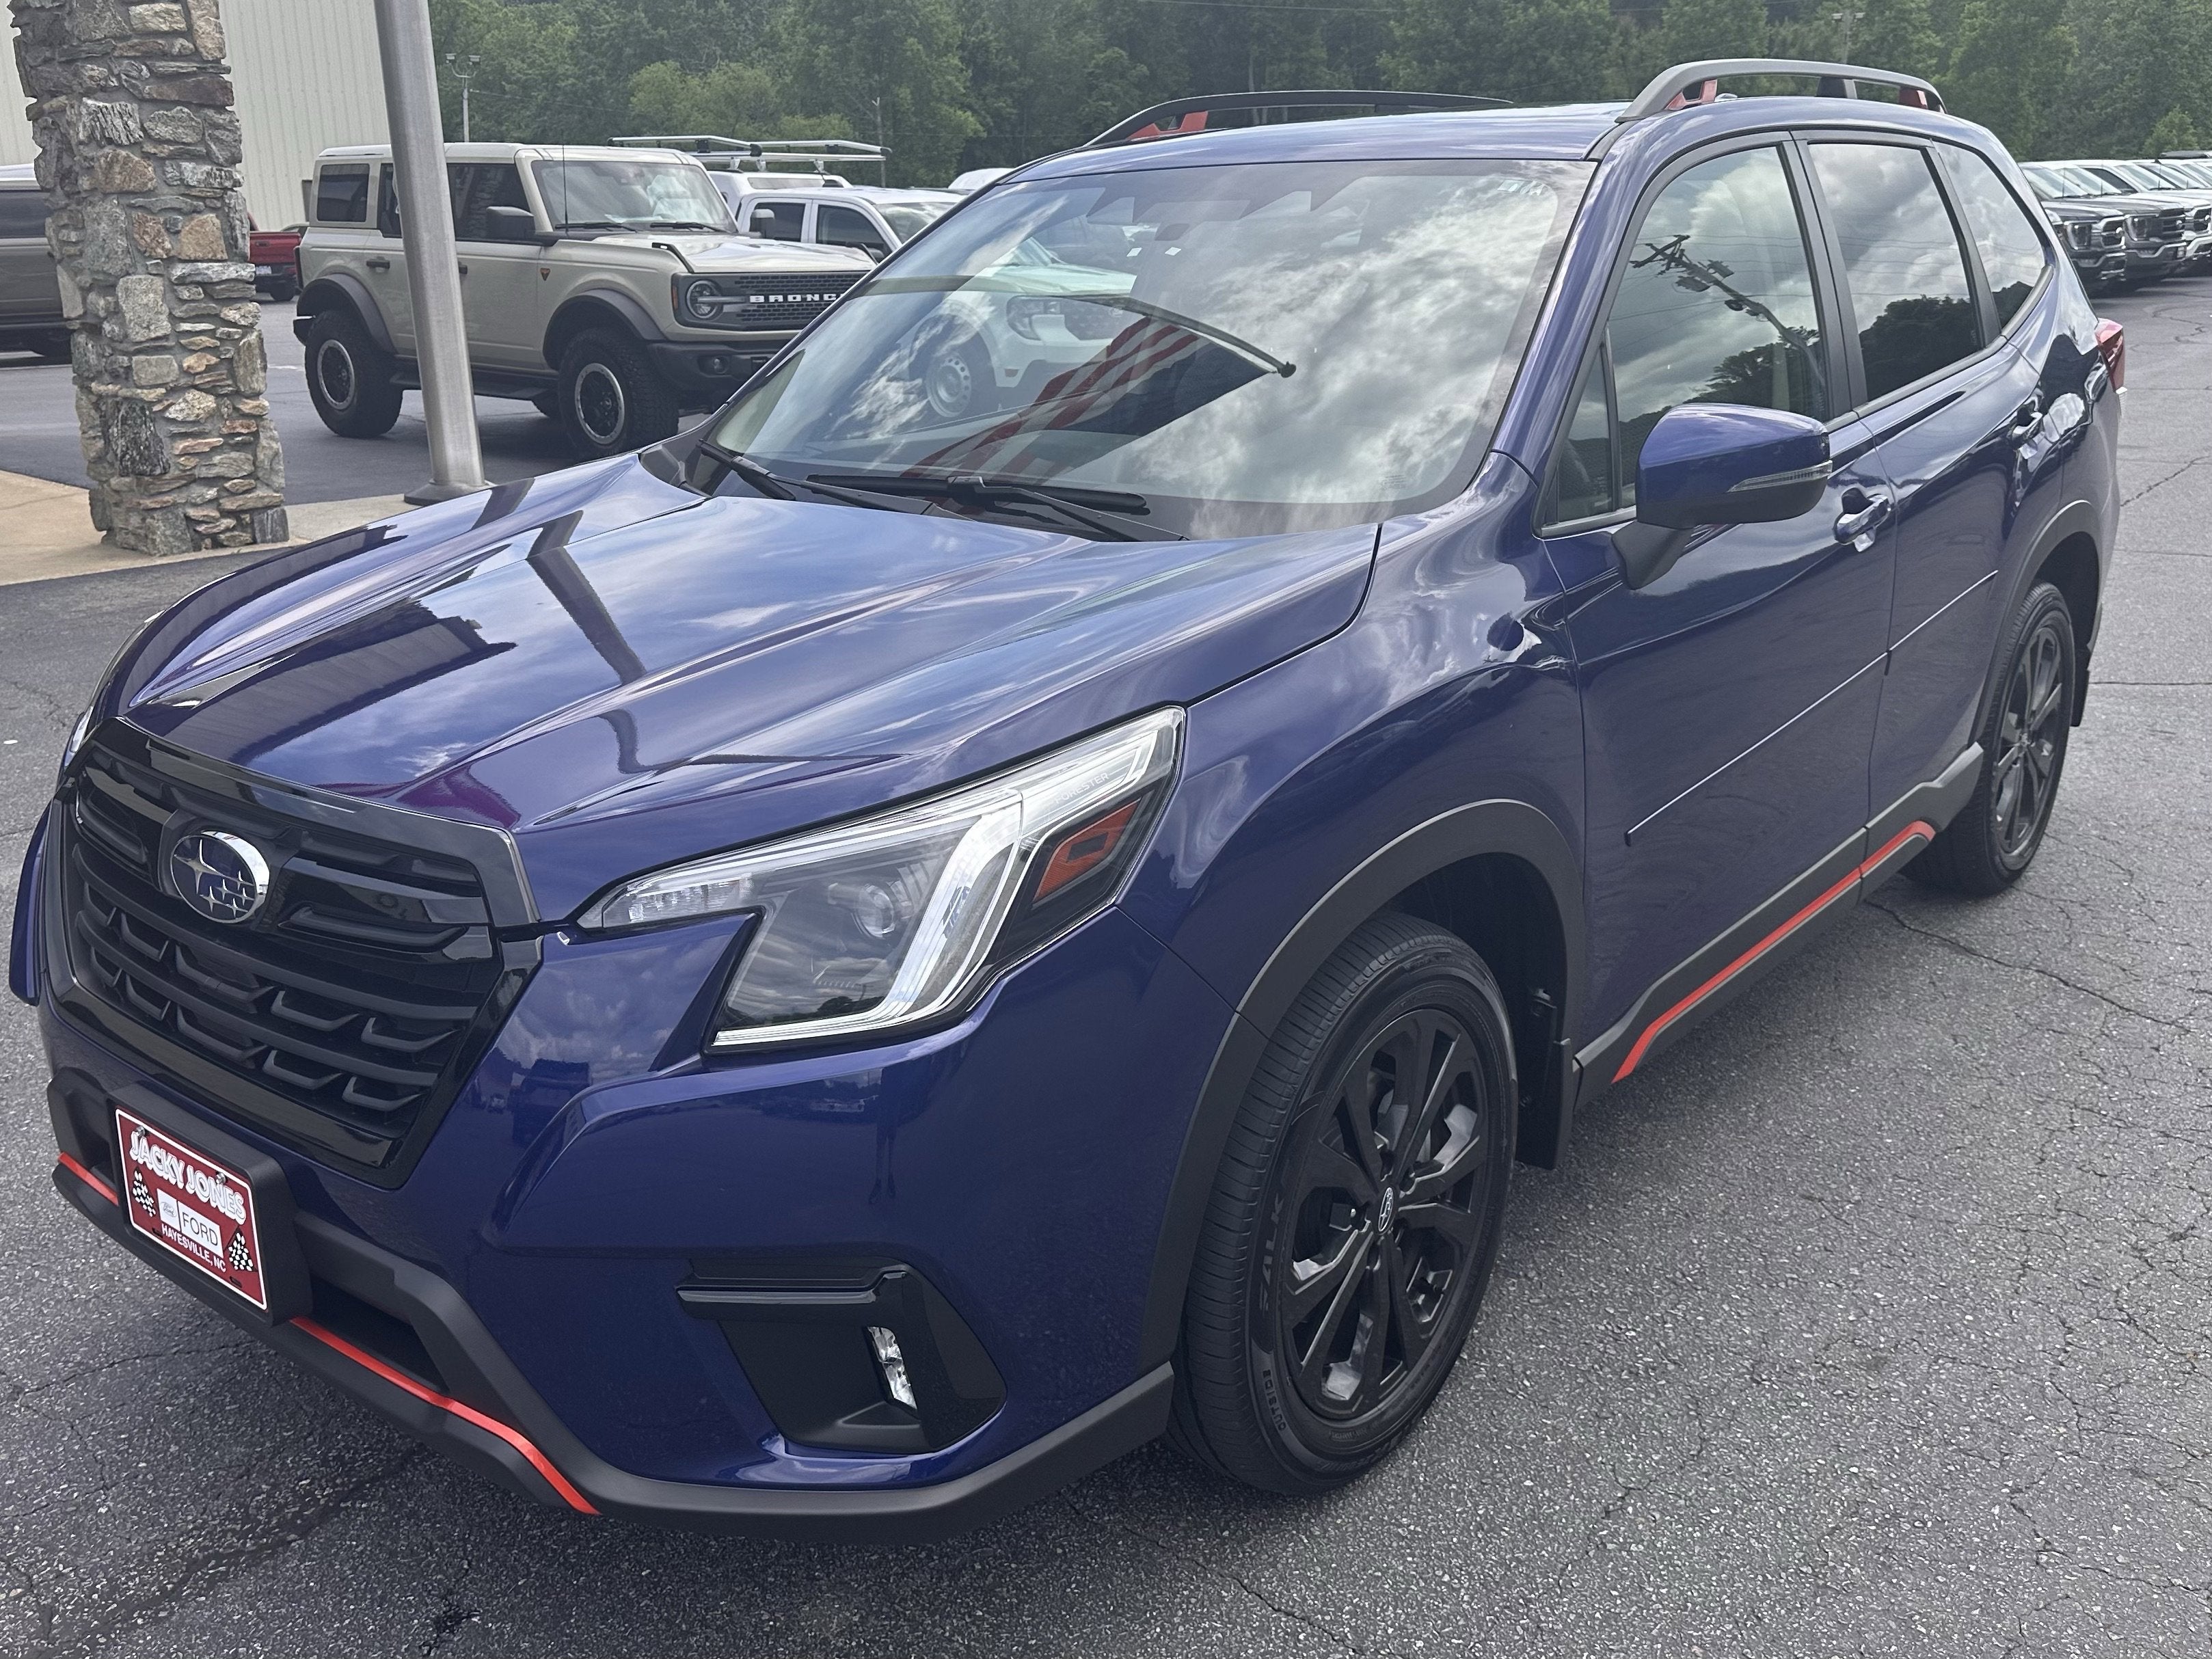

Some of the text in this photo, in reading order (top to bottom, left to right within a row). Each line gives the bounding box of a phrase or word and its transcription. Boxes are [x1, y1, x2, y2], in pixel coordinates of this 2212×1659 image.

[749, 293, 844, 303] BRONC
[1053, 772, 1109, 804] FORESTER
[130, 1131, 247, 1225] JACKY JONES
[161, 1223, 226, 1273] HAYESVILLE, NC
[182, 1212, 218, 1246] FORD
[1263, 1369, 1286, 1431] OUTSIDE
